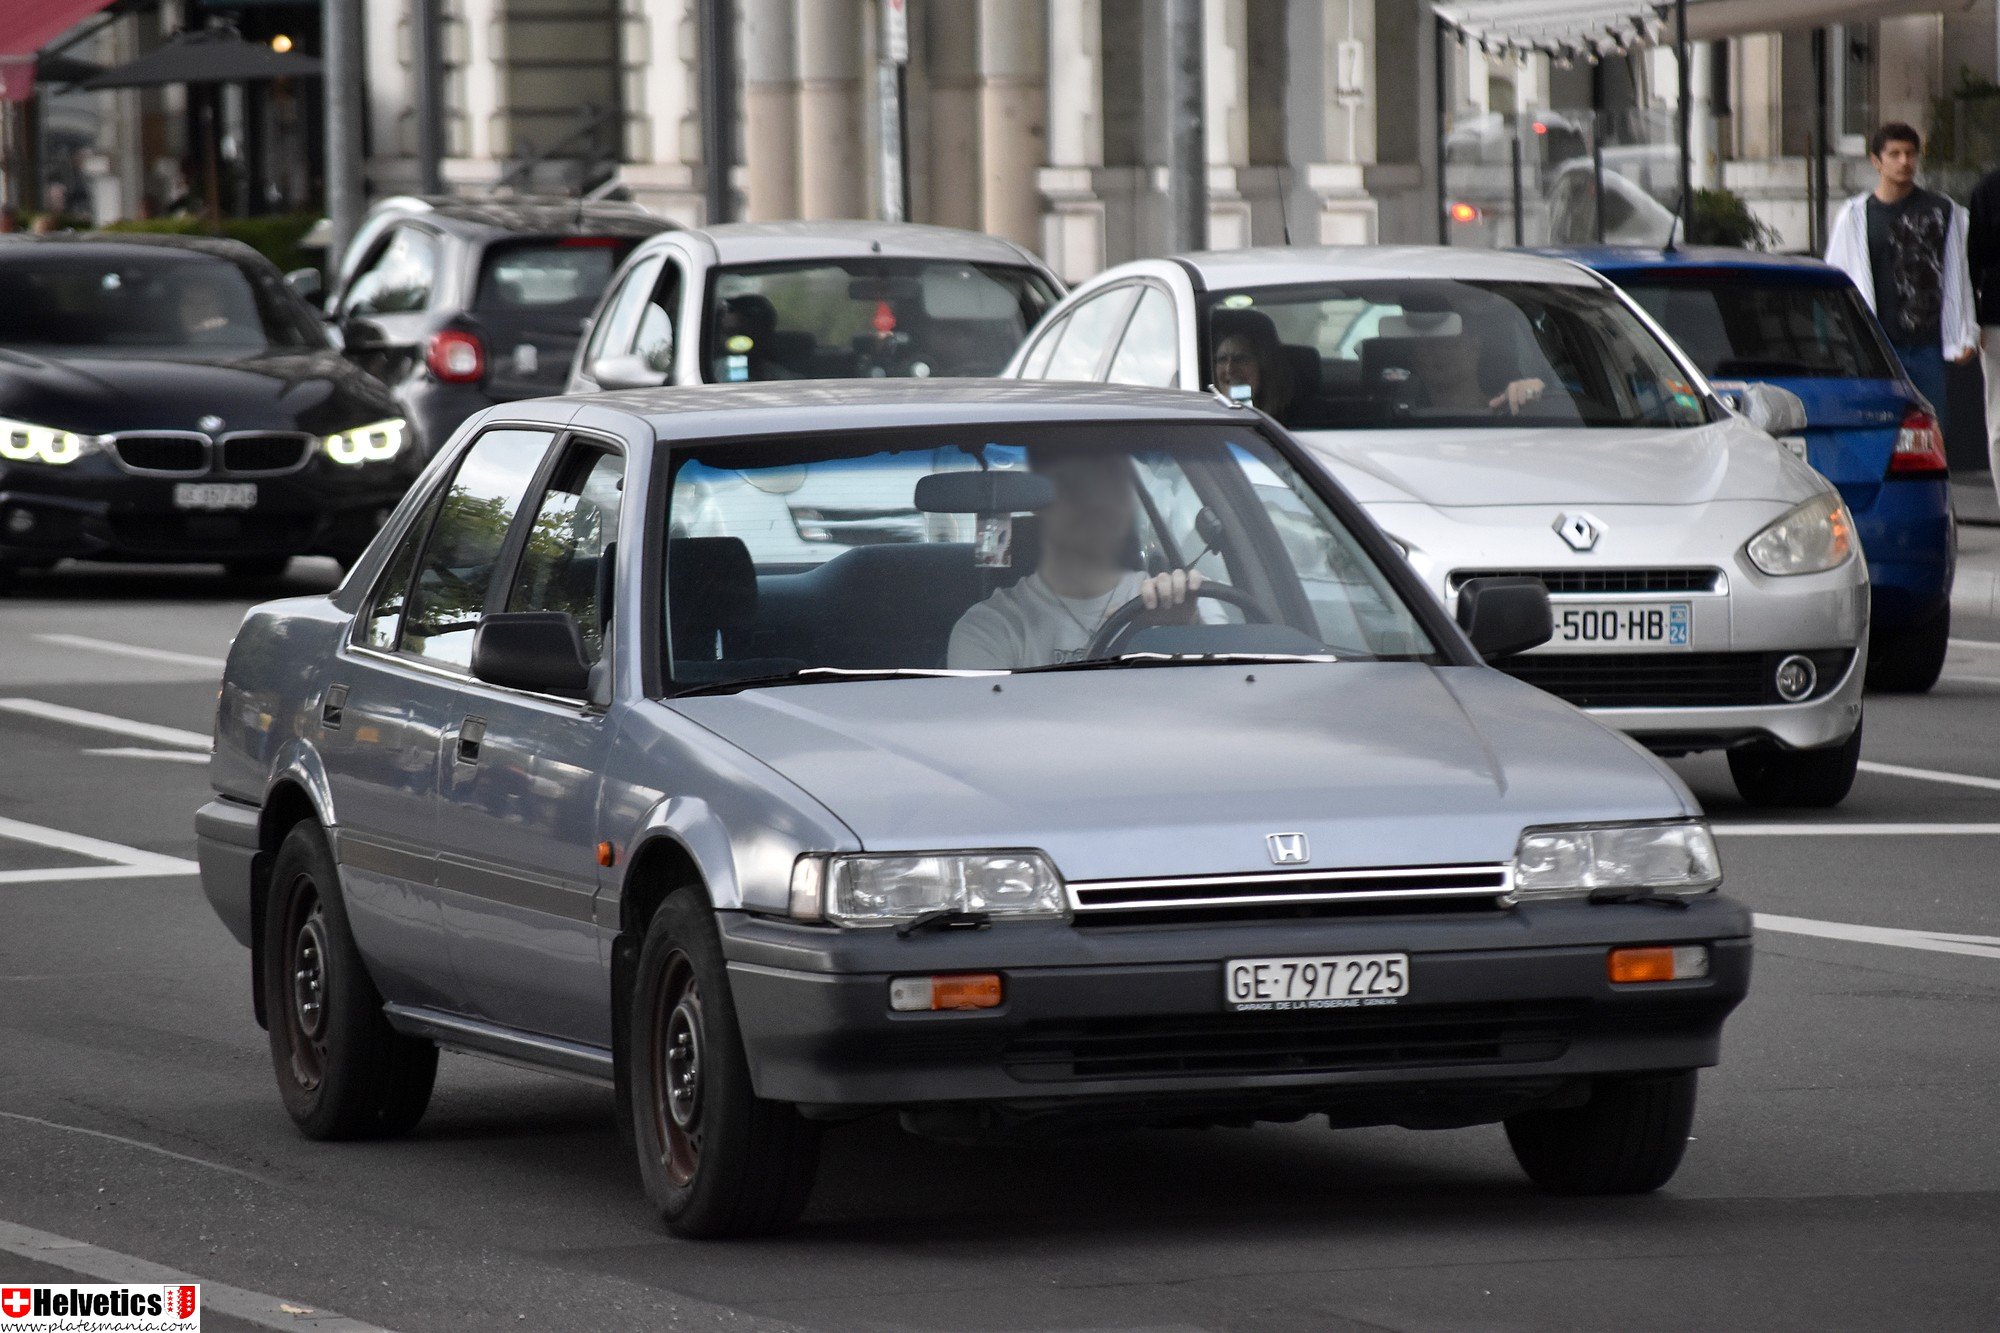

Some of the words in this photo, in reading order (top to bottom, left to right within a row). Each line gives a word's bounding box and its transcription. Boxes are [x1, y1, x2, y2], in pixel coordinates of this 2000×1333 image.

[1346, 959, 1403, 994] 225
[1237, 1002, 1273, 1011] GARAGE
[1276, 1001, 1292, 1010] DE
[1293, 1000, 1307, 1009] LA
